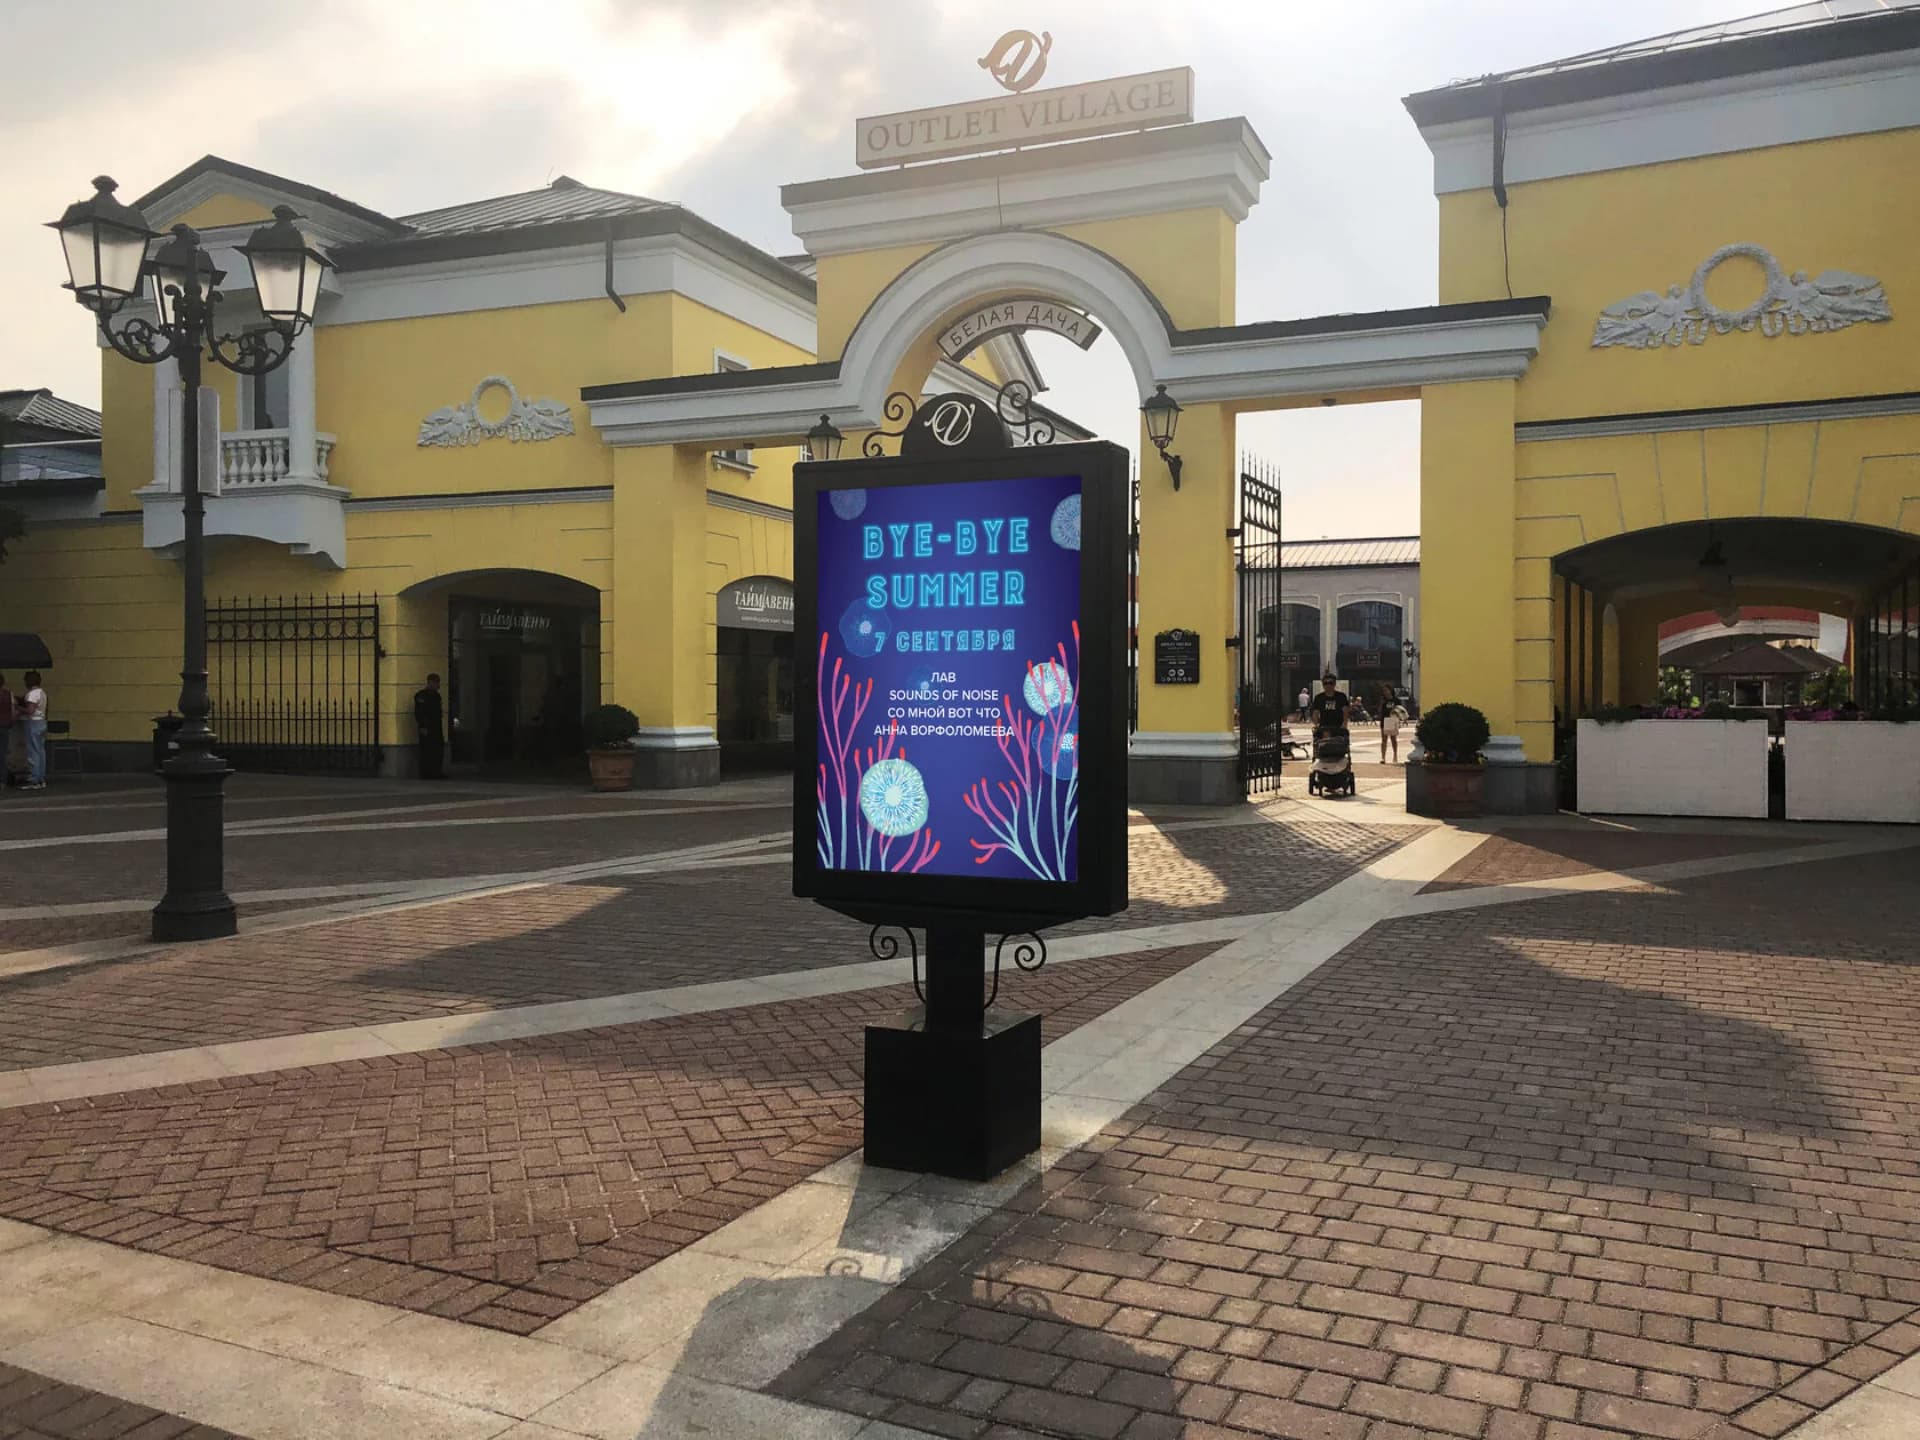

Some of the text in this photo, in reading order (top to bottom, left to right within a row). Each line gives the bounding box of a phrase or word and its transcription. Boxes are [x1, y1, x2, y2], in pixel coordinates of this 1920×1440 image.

[867, 80, 1176, 151] OUTLET VILLAGE
[950, 305, 1081, 347] БЕЛАЯ ДАЧА
[863, 517, 1030, 560] BYE-BYE
[866, 570, 1025, 609] SUMMER
[874, 628, 1016, 653] 7 СЕНТЯБРЯ
[931, 671, 957, 683] ЛАВ
[889, 689, 999, 701] SOUNDS OF NOISE
[887, 705, 1001, 718] СО МНОЙ ВОТ ЧТО
[873, 725, 1016, 737] АННА ВОРФОЛОМЕЕВА
